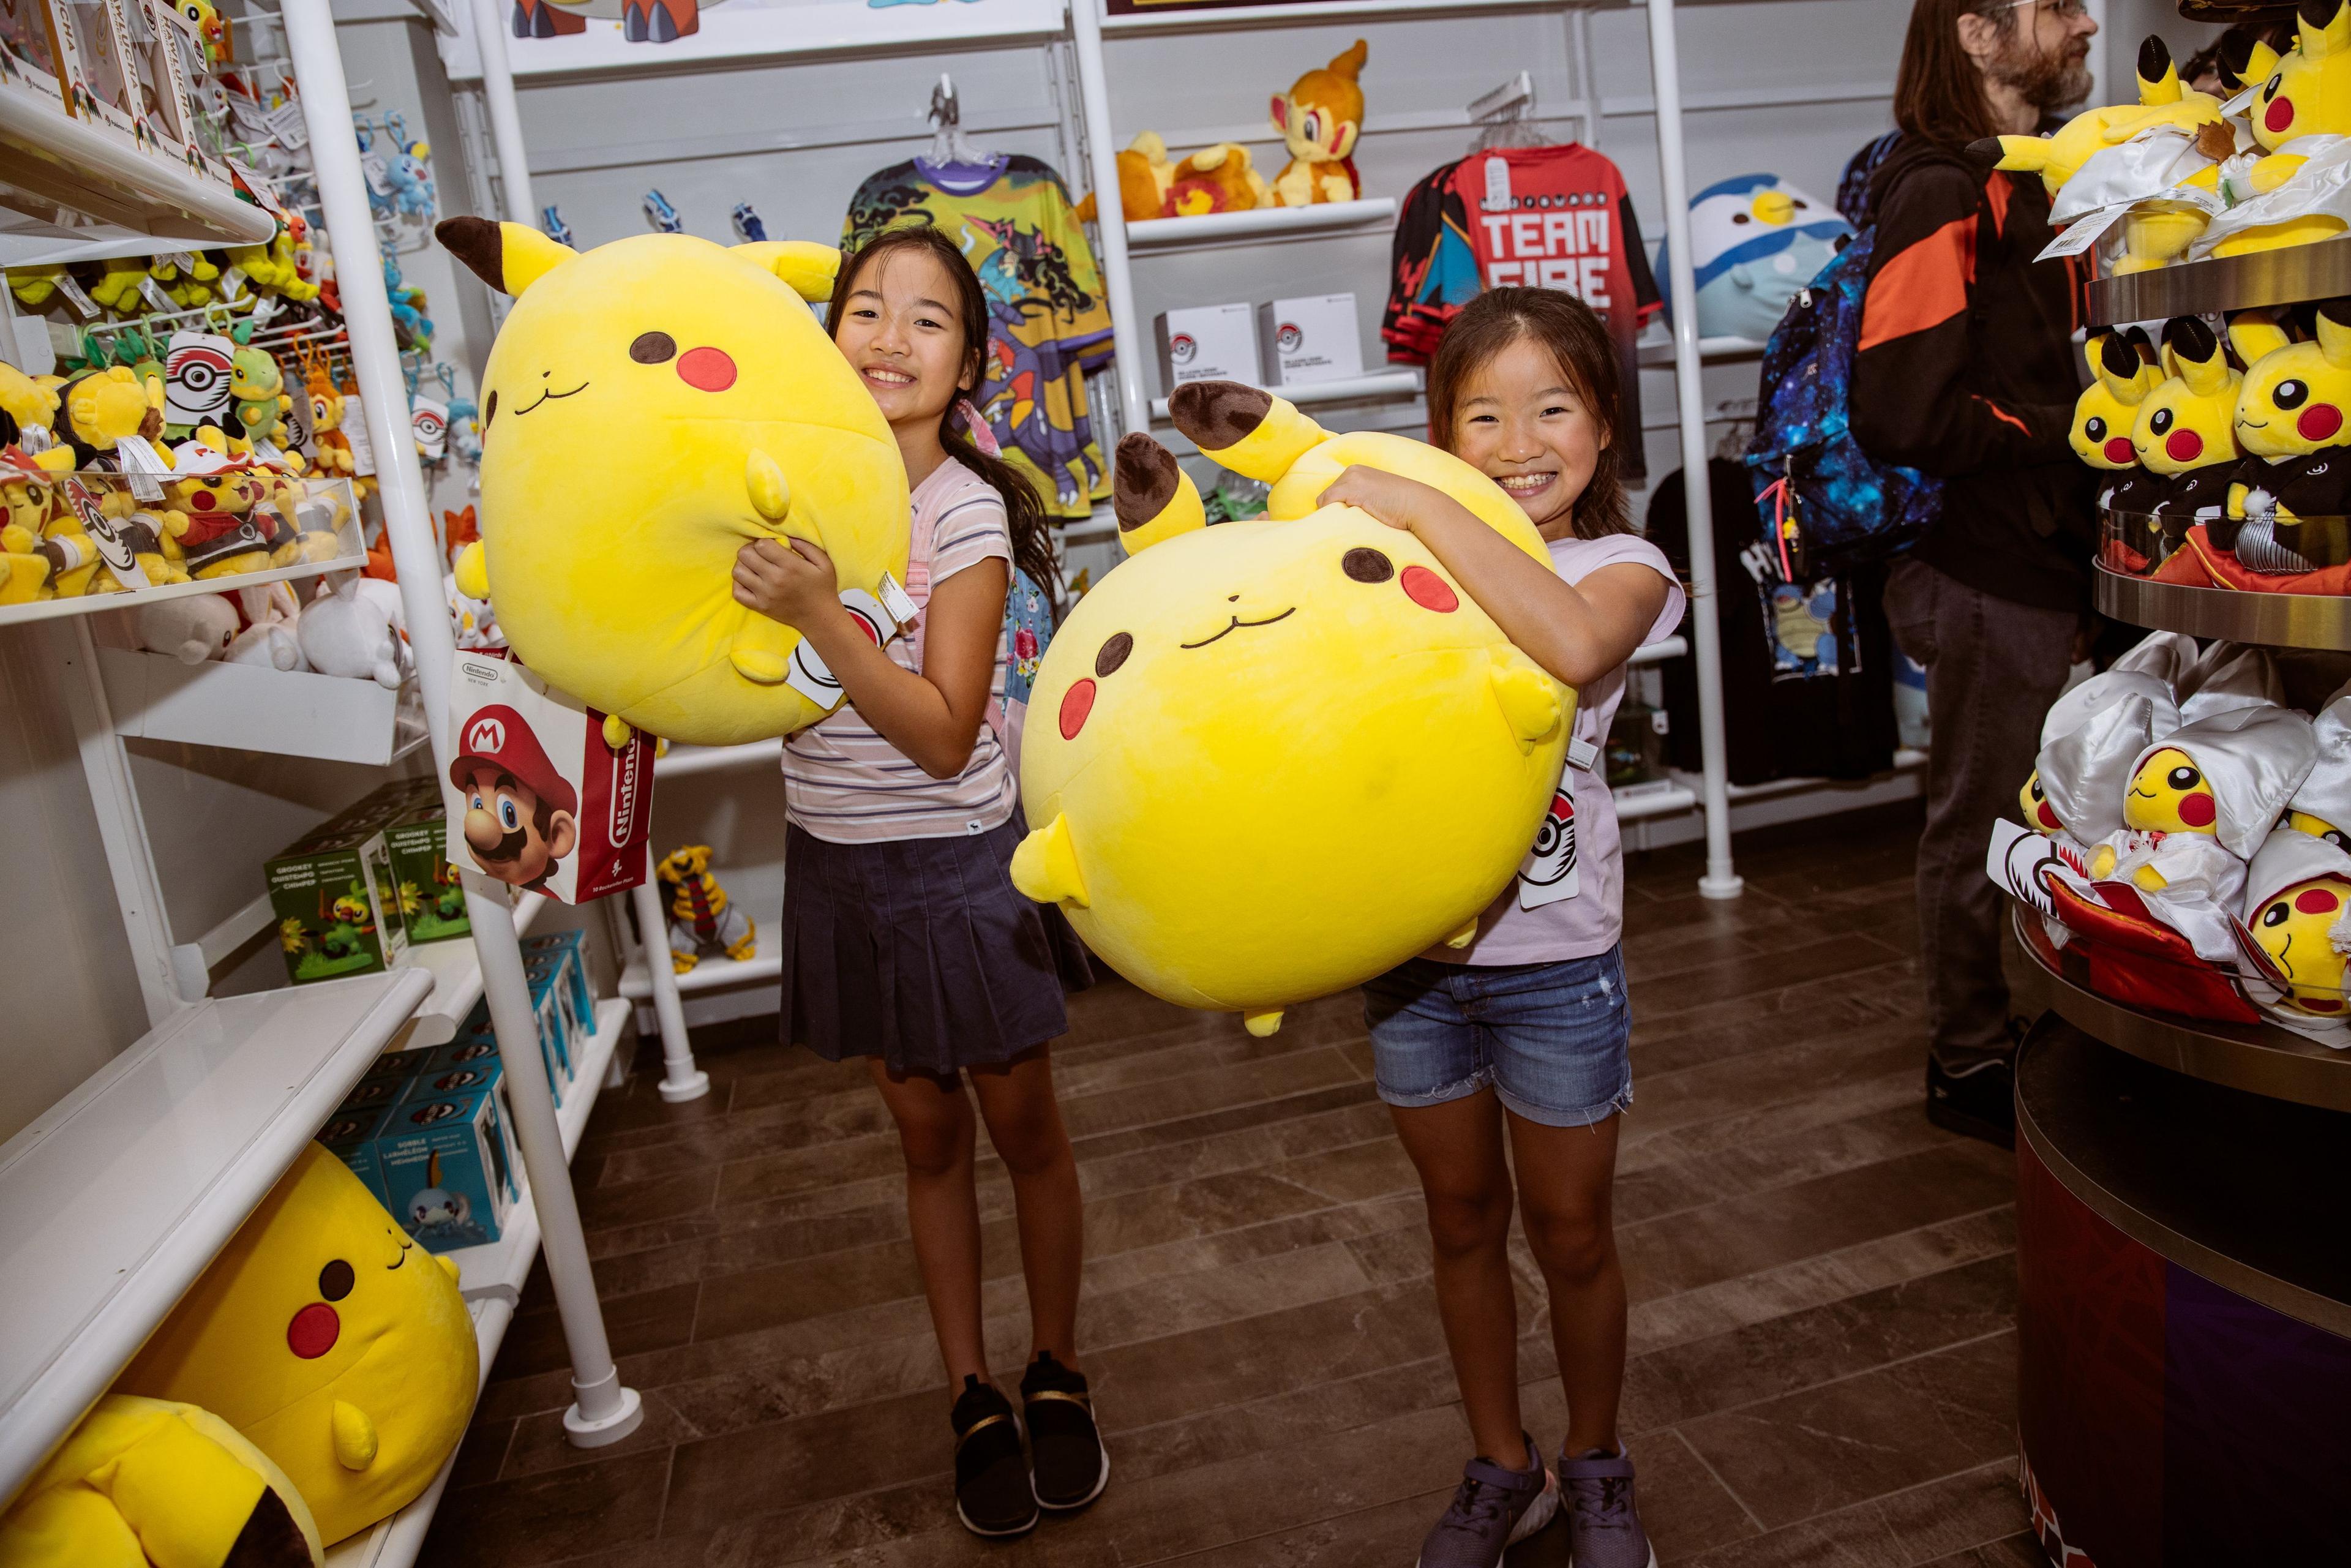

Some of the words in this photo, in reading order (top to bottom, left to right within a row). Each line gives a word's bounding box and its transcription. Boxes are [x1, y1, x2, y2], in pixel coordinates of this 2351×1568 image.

[163, 15, 190, 119] HAWLUCHA
[1480, 210, 1610, 258] TEAM
[1488, 256, 1611, 308] FIRE
[466, 666, 495, 678] Nintendo
[396, 830, 429, 840] GROOKEY
[391, 836, 432, 849] OUISTEMPO
[401, 844, 433, 855] CHIMPEP
[276, 863, 313, 874] GROOKEY
[271, 871, 315, 883] OUISTEMPO
[283, 879, 317, 890] CHIMPEP
